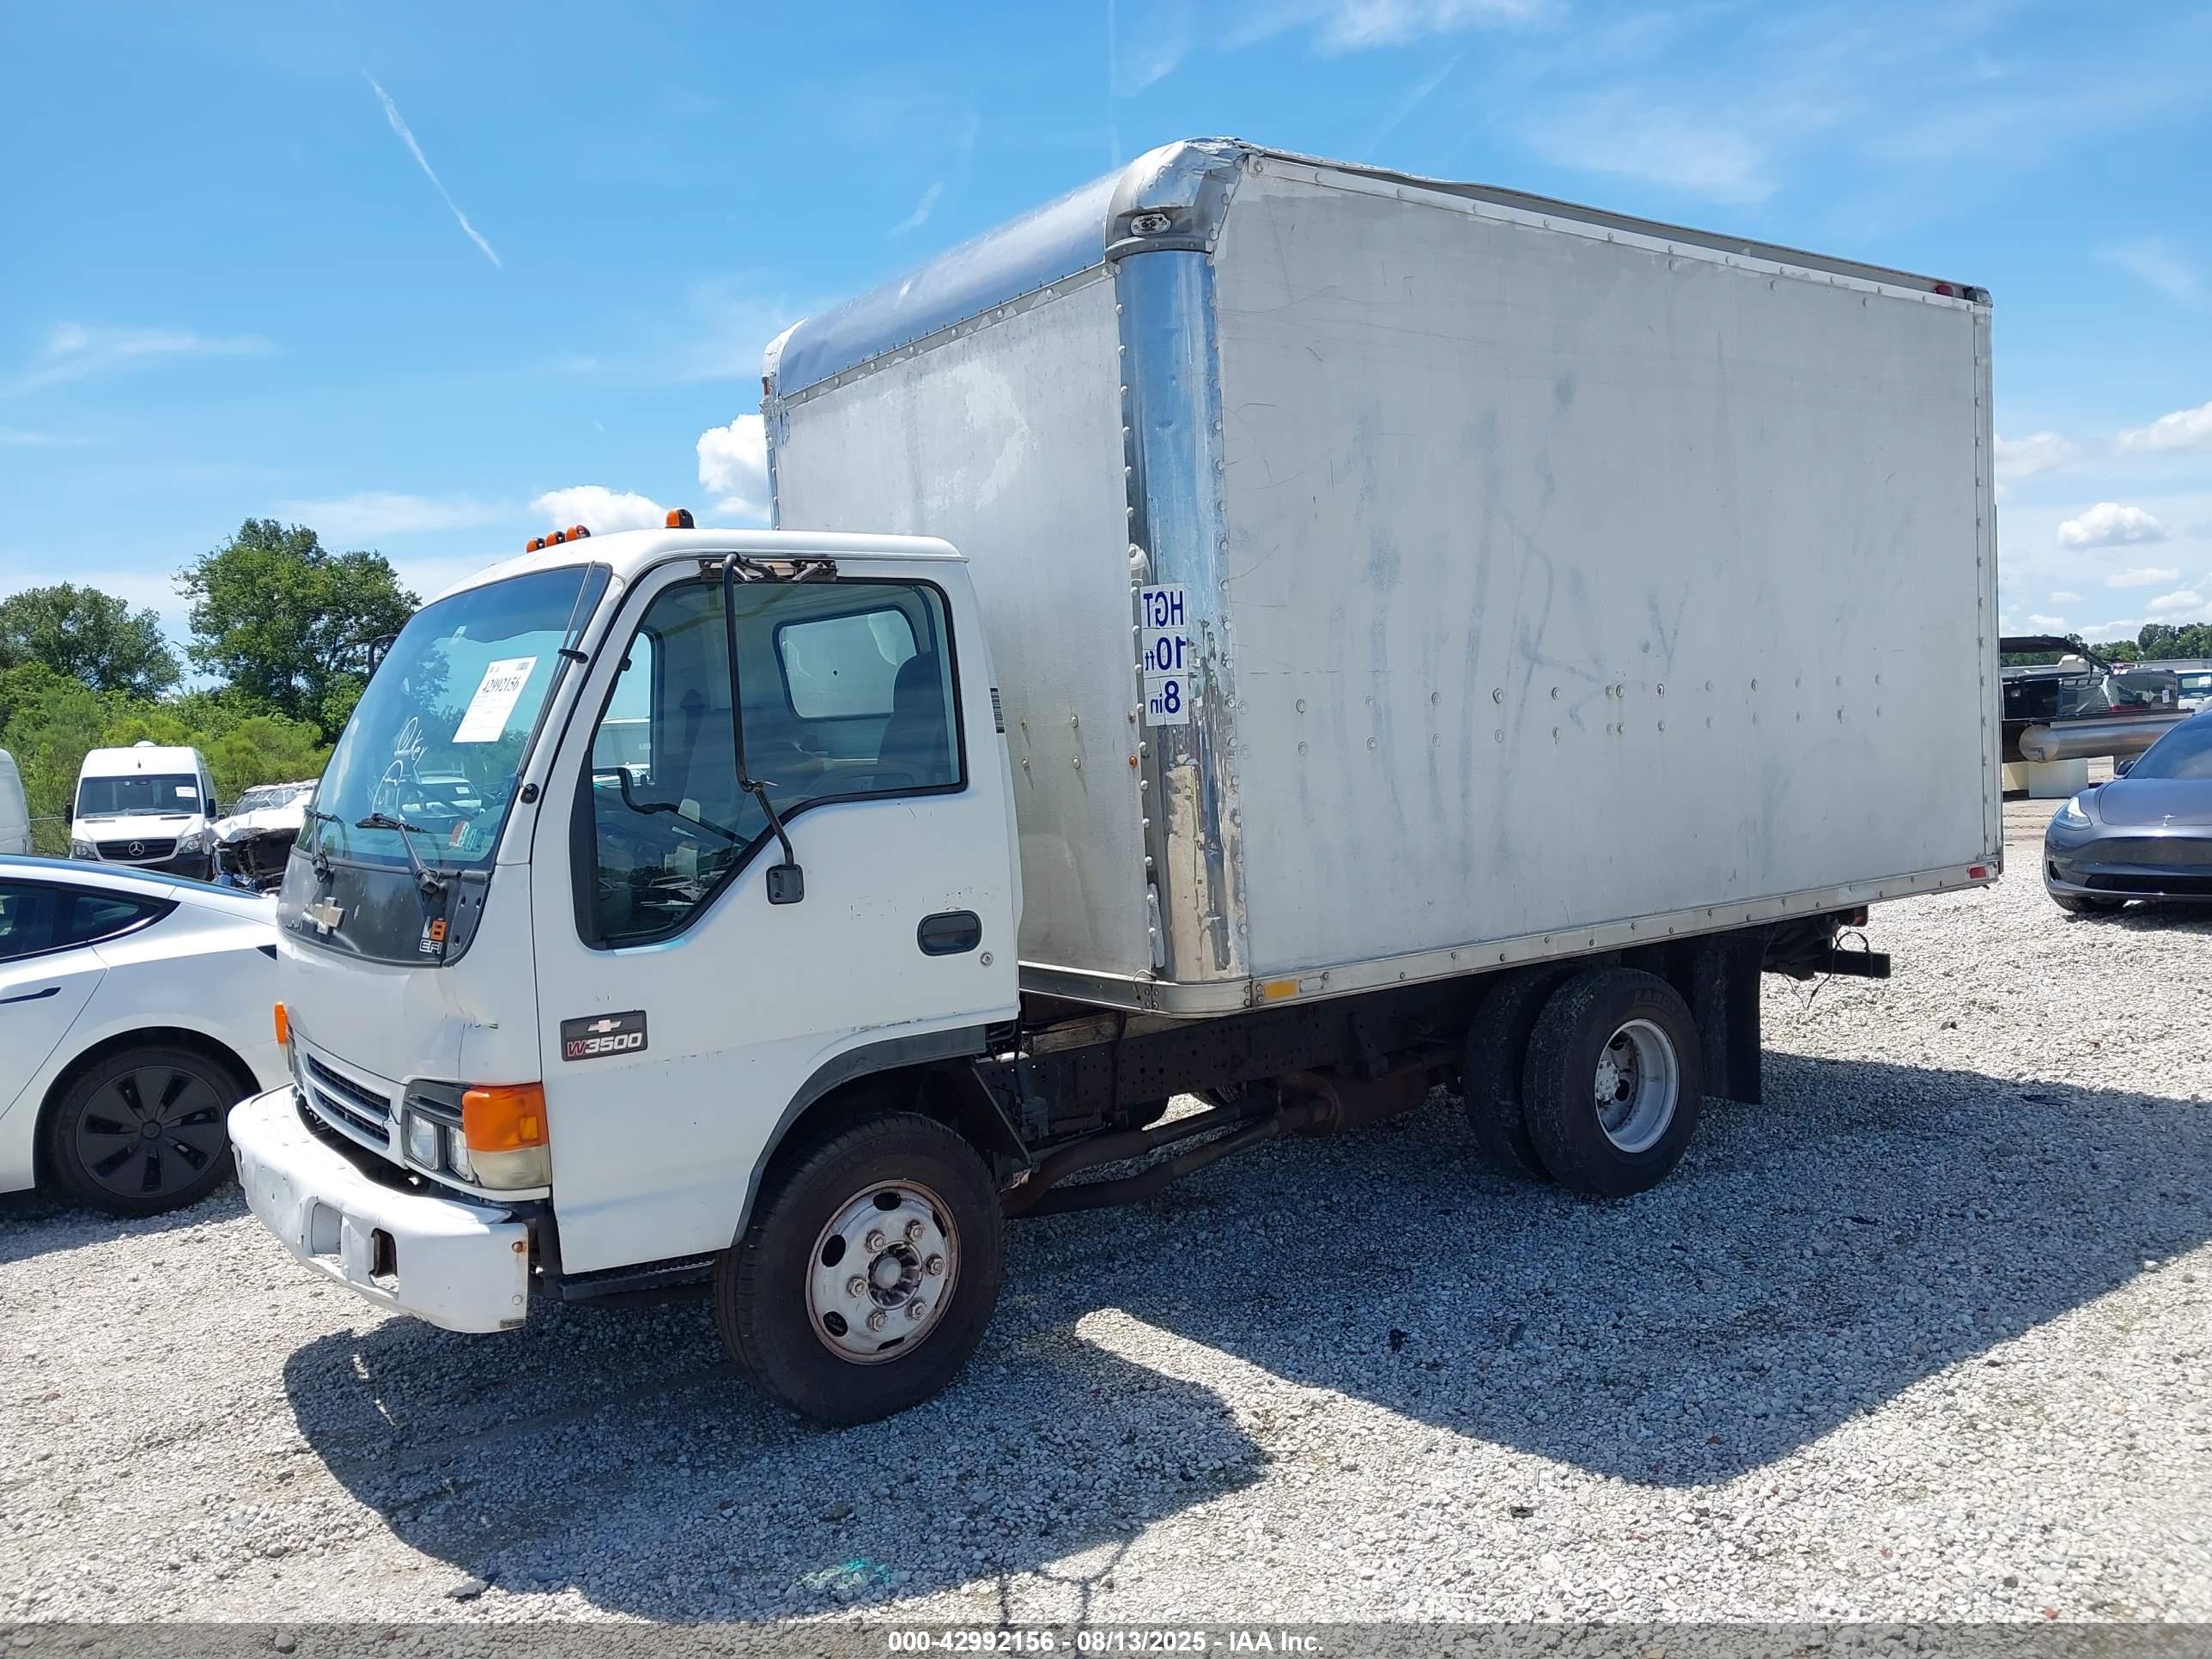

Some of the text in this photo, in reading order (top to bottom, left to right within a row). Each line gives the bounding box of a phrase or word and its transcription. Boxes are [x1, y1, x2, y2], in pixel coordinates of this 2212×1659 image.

[482, 675, 522, 694] 42992156
[419, 939, 442, 954] EFI
[567, 1032, 643, 1057] W3500
